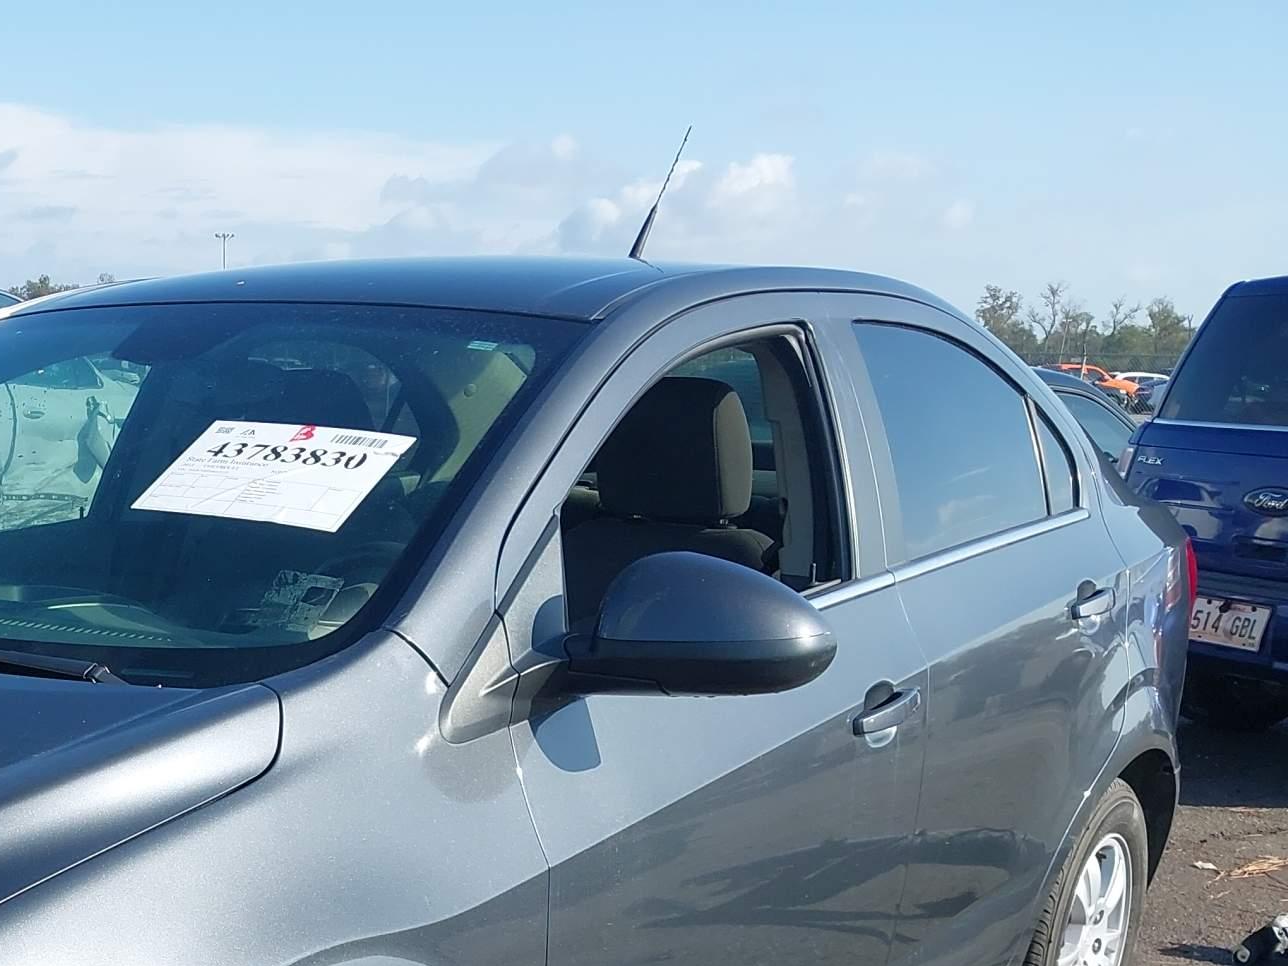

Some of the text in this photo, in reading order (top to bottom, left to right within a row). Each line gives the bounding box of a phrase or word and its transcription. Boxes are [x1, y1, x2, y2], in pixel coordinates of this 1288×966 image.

[207, 441, 368, 470] 43783830
[1137, 455, 1163, 465] FLEX
[1254, 492, 1288, 509] Ford
[1191, 609, 1257, 640] 514 GBL
